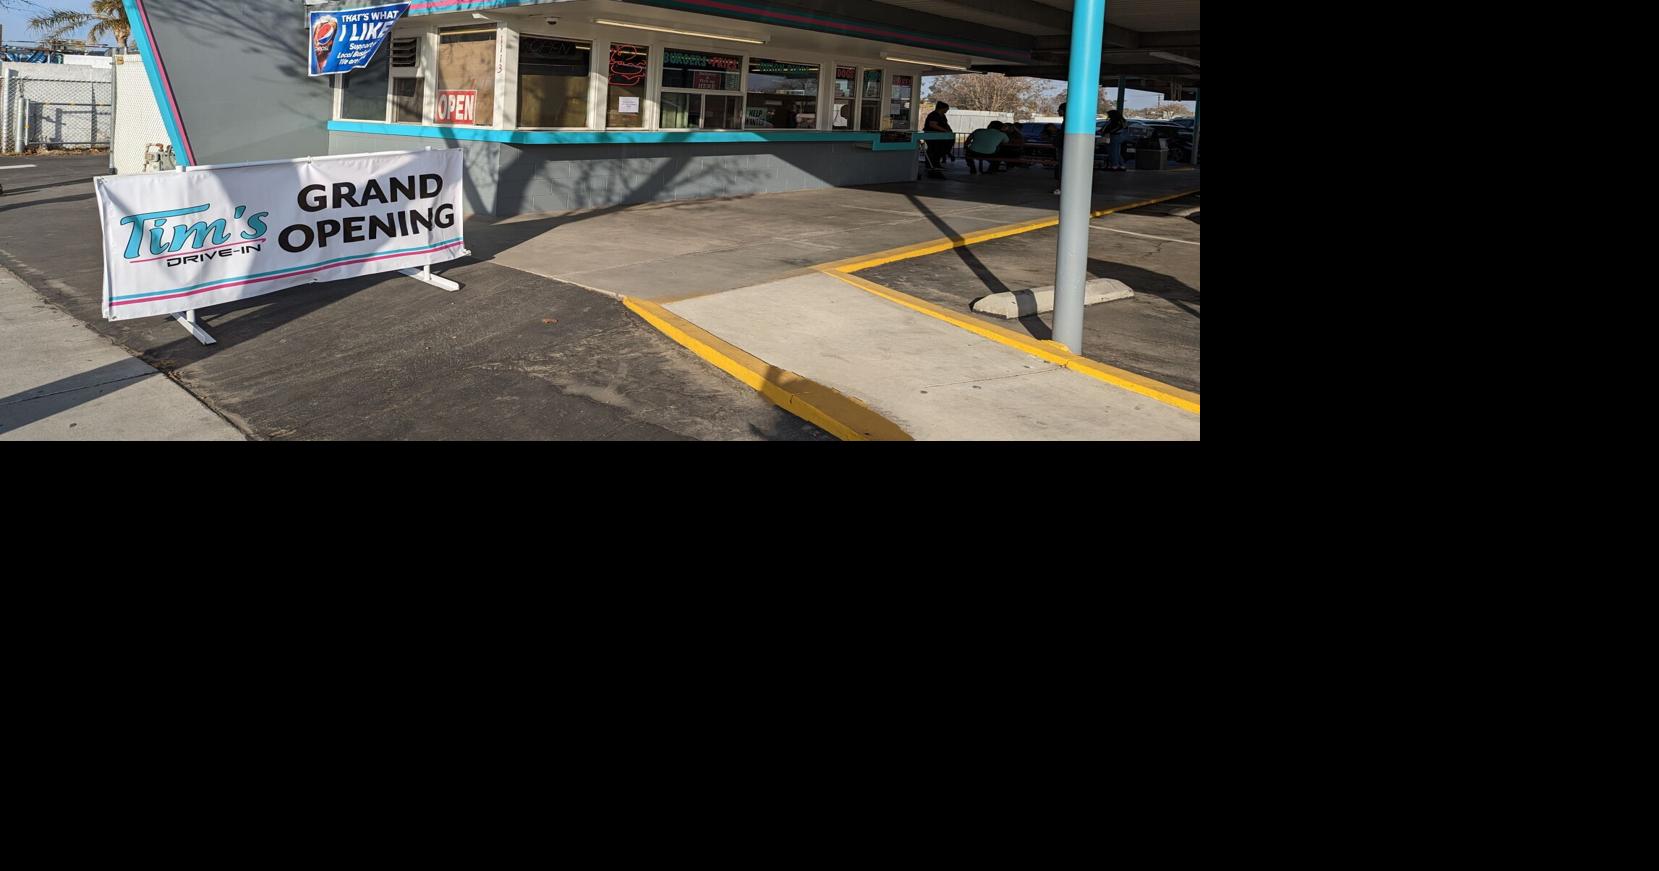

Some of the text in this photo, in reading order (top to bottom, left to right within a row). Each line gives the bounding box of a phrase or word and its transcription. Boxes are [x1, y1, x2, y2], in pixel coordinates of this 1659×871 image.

[342, 10, 399, 23] THAT'S WHAT
[338, 20, 394, 42] I LIKE
[664, 51, 707, 67] BURGERS
[438, 93, 475, 121] OPEN
[297, 173, 443, 213] GRAND
[120, 203, 269, 259] Tim's
[278, 203, 455, 253] OPENING
[166, 244, 262, 268] DRIVE-IN
